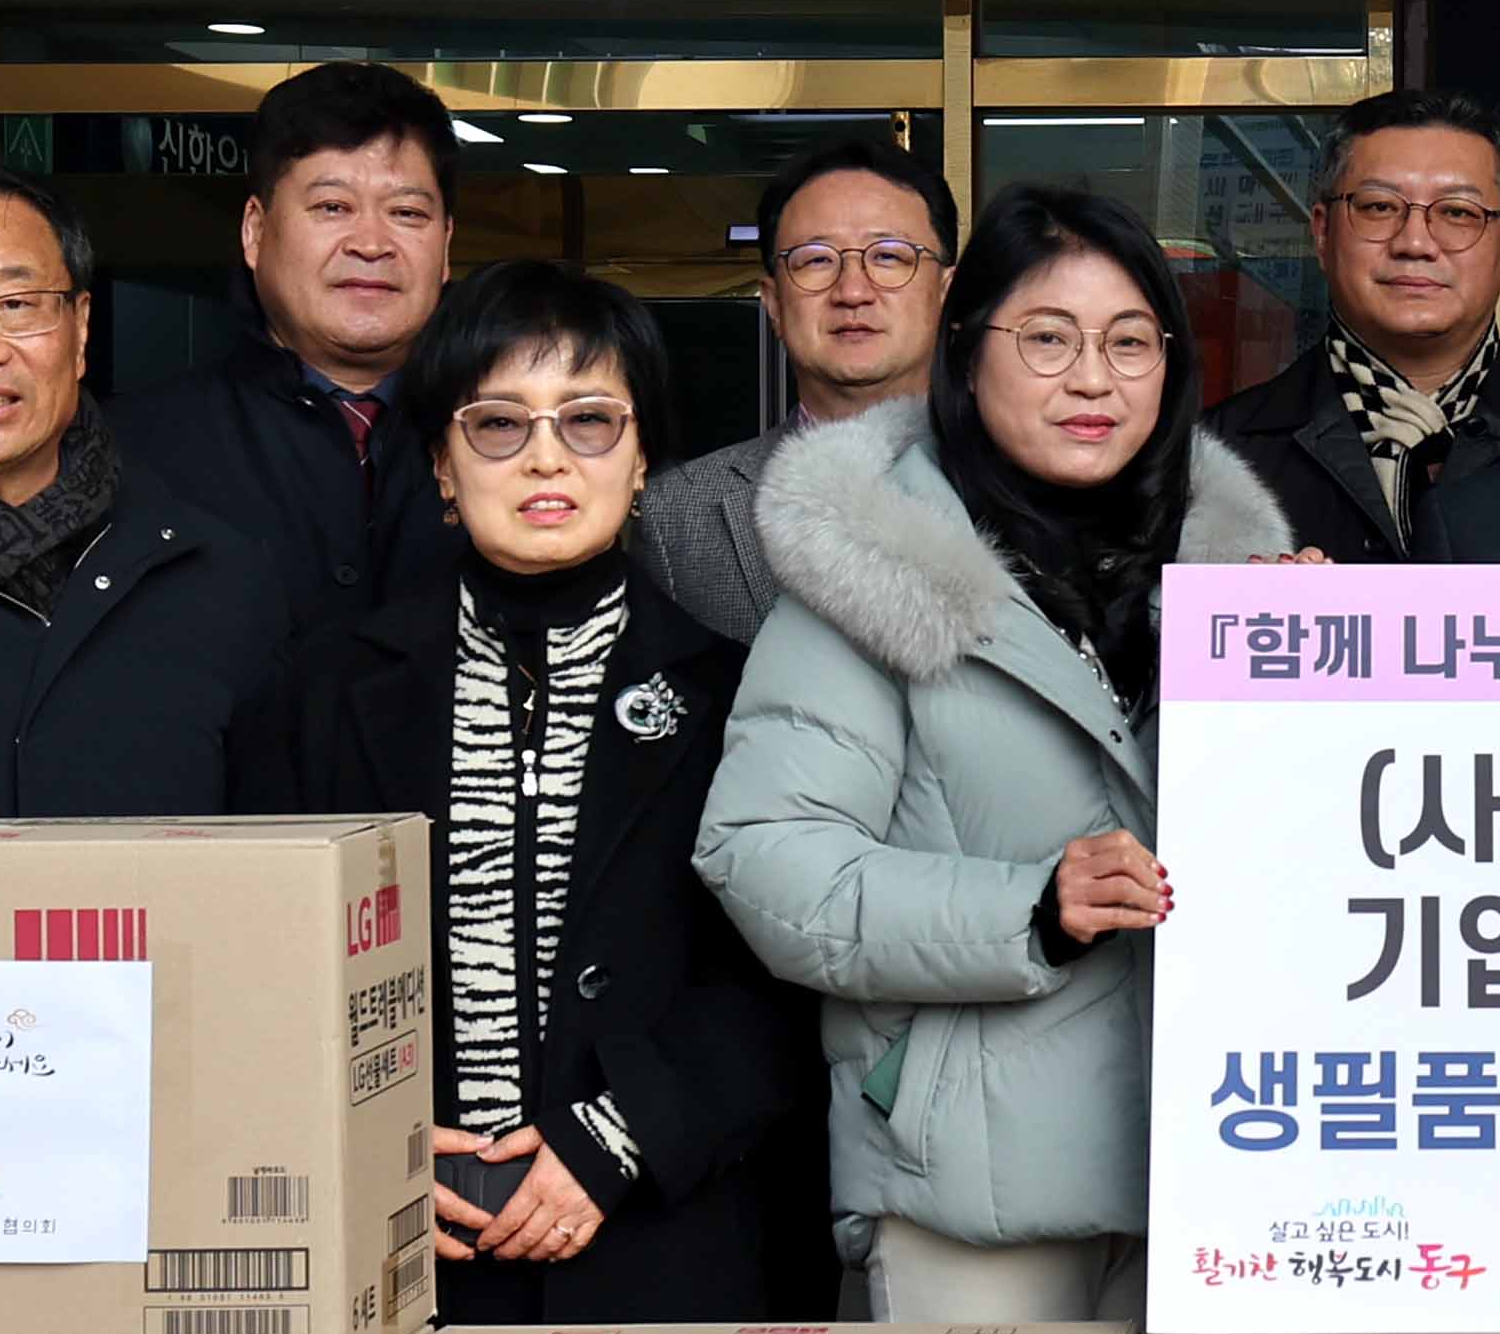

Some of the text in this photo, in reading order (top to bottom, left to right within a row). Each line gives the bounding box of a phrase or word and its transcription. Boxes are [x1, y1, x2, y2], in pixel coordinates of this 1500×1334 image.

[1209, 612, 1373, 680] 『함께
[347, 895, 372, 957] LG
[349, 964, 426, 1048] 월드트레블에디션
[1270, 1220, 1409, 1243] 살고 싶은 도시!
[1193, 1243, 1488, 1290] 활기찬 행복도시 동구
